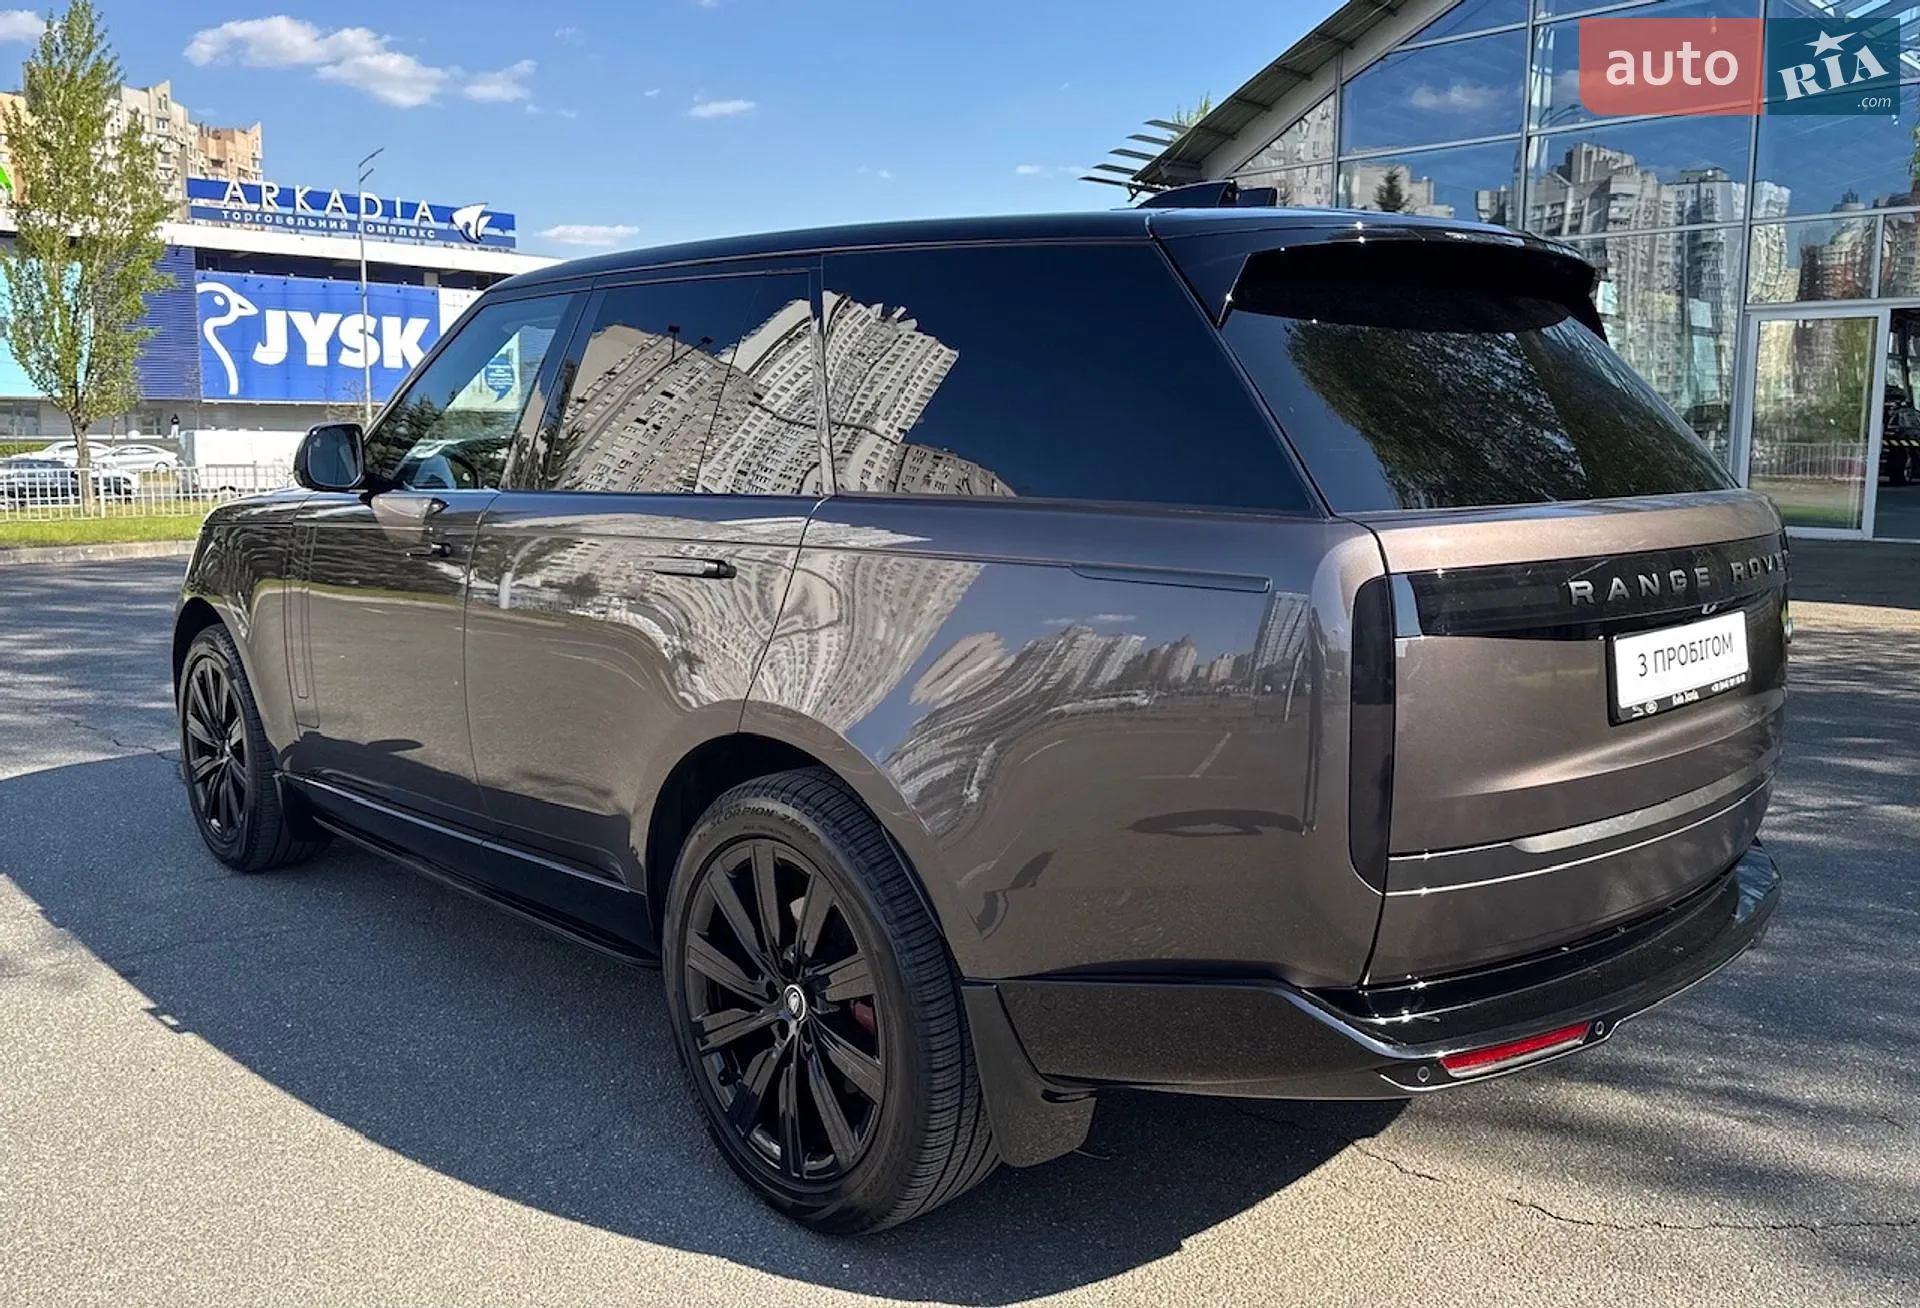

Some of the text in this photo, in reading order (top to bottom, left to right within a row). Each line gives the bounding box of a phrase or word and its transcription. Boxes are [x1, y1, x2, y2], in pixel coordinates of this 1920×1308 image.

[221, 209, 349, 231] торговельний
[223, 180, 436, 225] ARKADIA
[252, 308, 431, 369] JYSK
[1568, 566, 1712, 606] RANGE
[1653, 632, 1734, 674] ПРОБІГОМ
